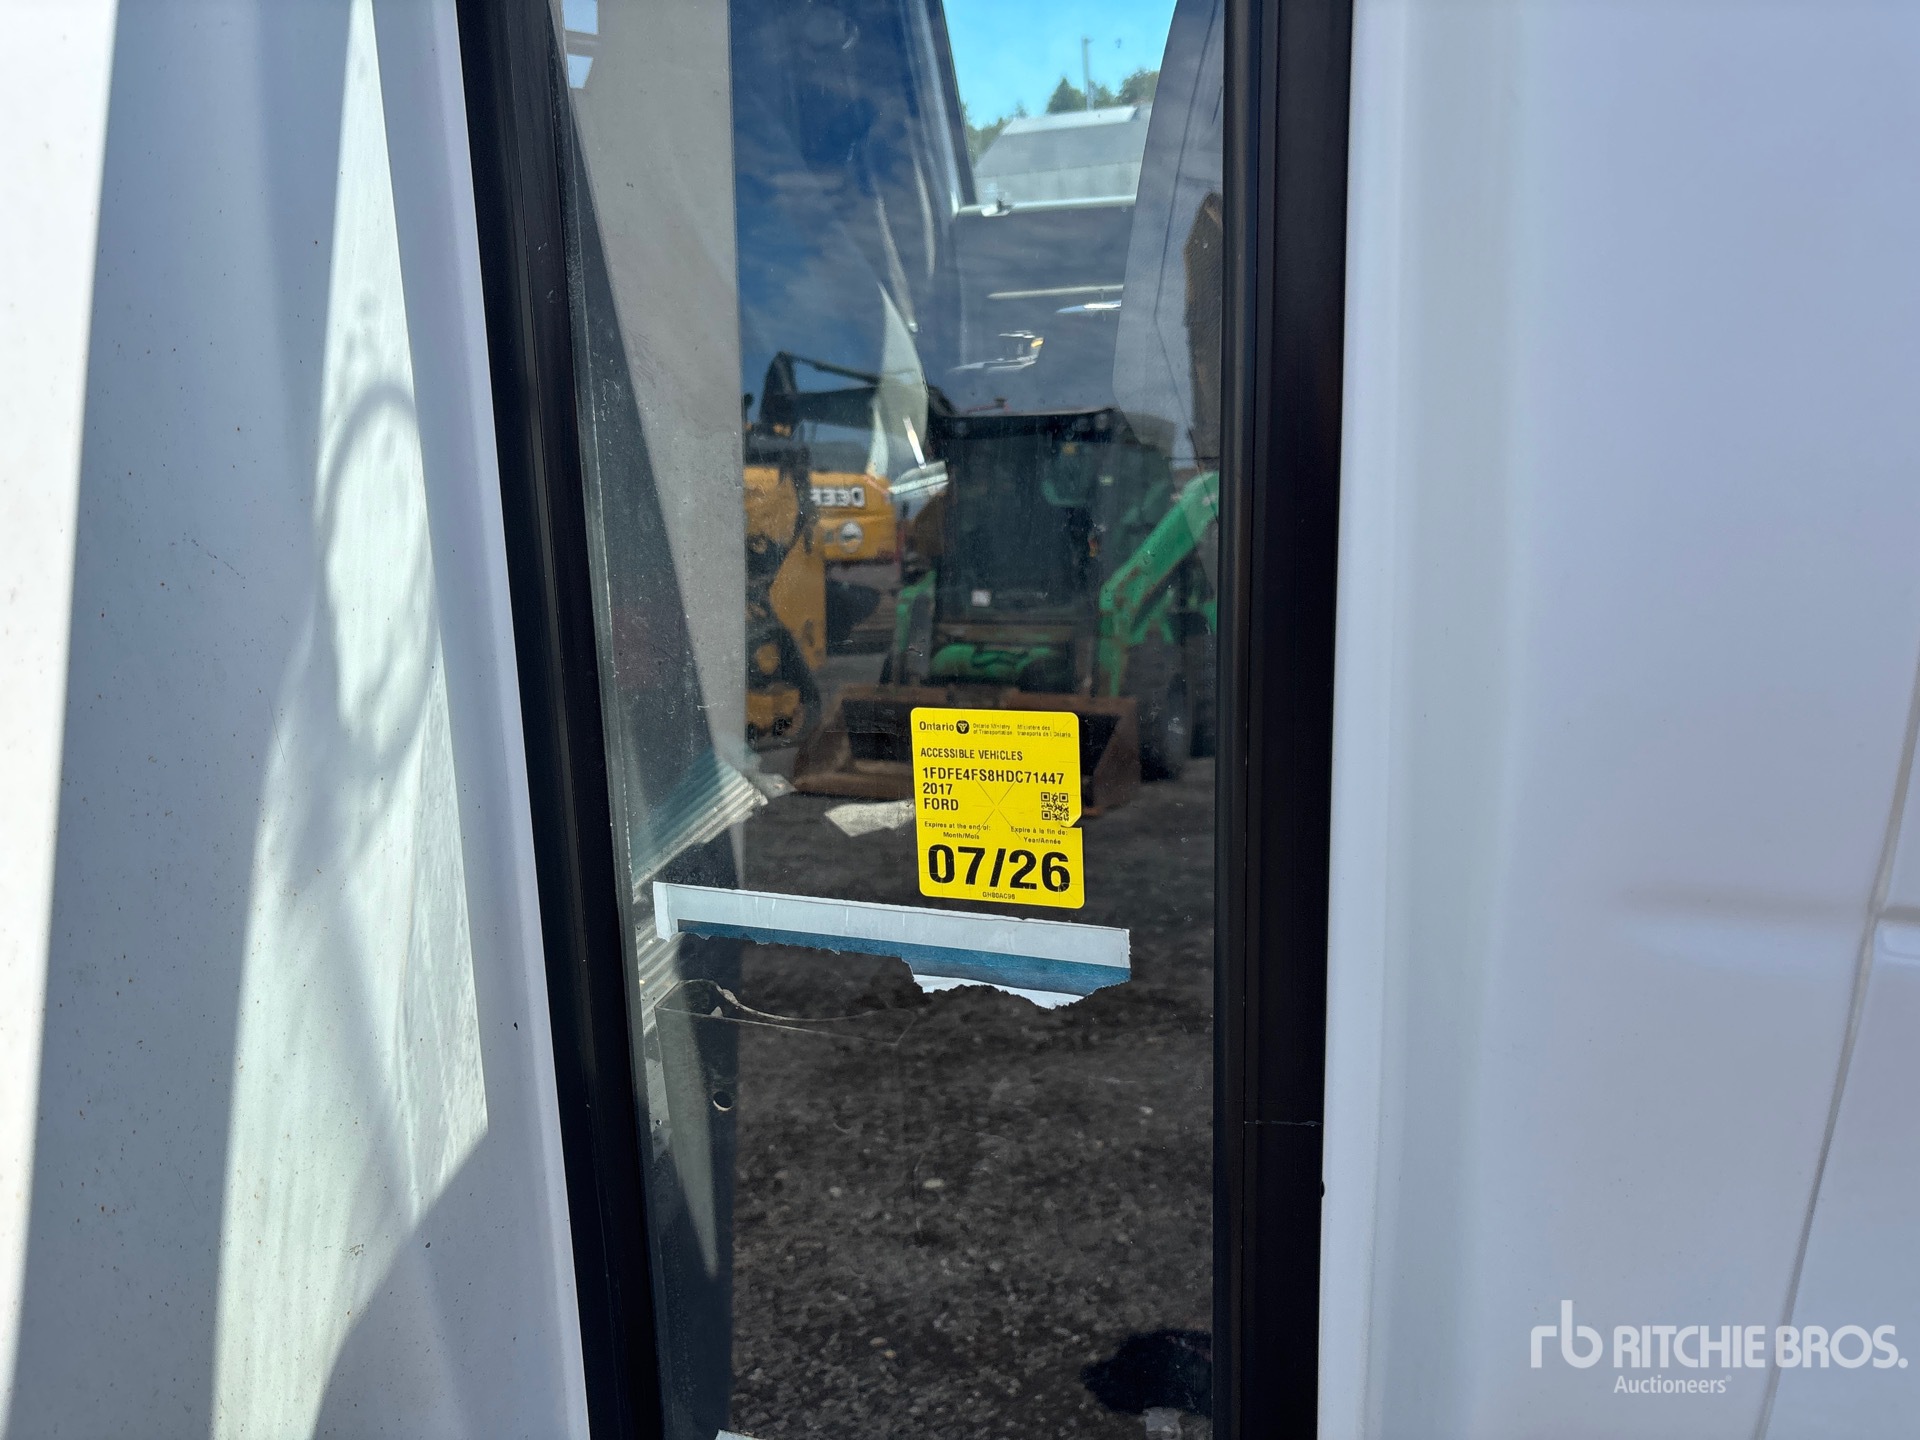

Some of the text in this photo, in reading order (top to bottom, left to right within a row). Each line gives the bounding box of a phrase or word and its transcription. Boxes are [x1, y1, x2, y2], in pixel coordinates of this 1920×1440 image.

[919, 721, 954, 732] Ontario
[920, 748, 1023, 761] ACCESSIBLE VEHICLES
[922, 767, 1065, 785] 1FDFE4FS8HDC71447
[922, 783, 953, 795] 2017
[924, 798, 959, 811] FORD
[924, 821, 947, 829] Expires
[1010, 826, 1031, 834] Expire
[943, 831, 980, 840] Month/Mois
[1023, 836, 1062, 845] Year/Année
[928, 844, 1071, 893] 07/26
